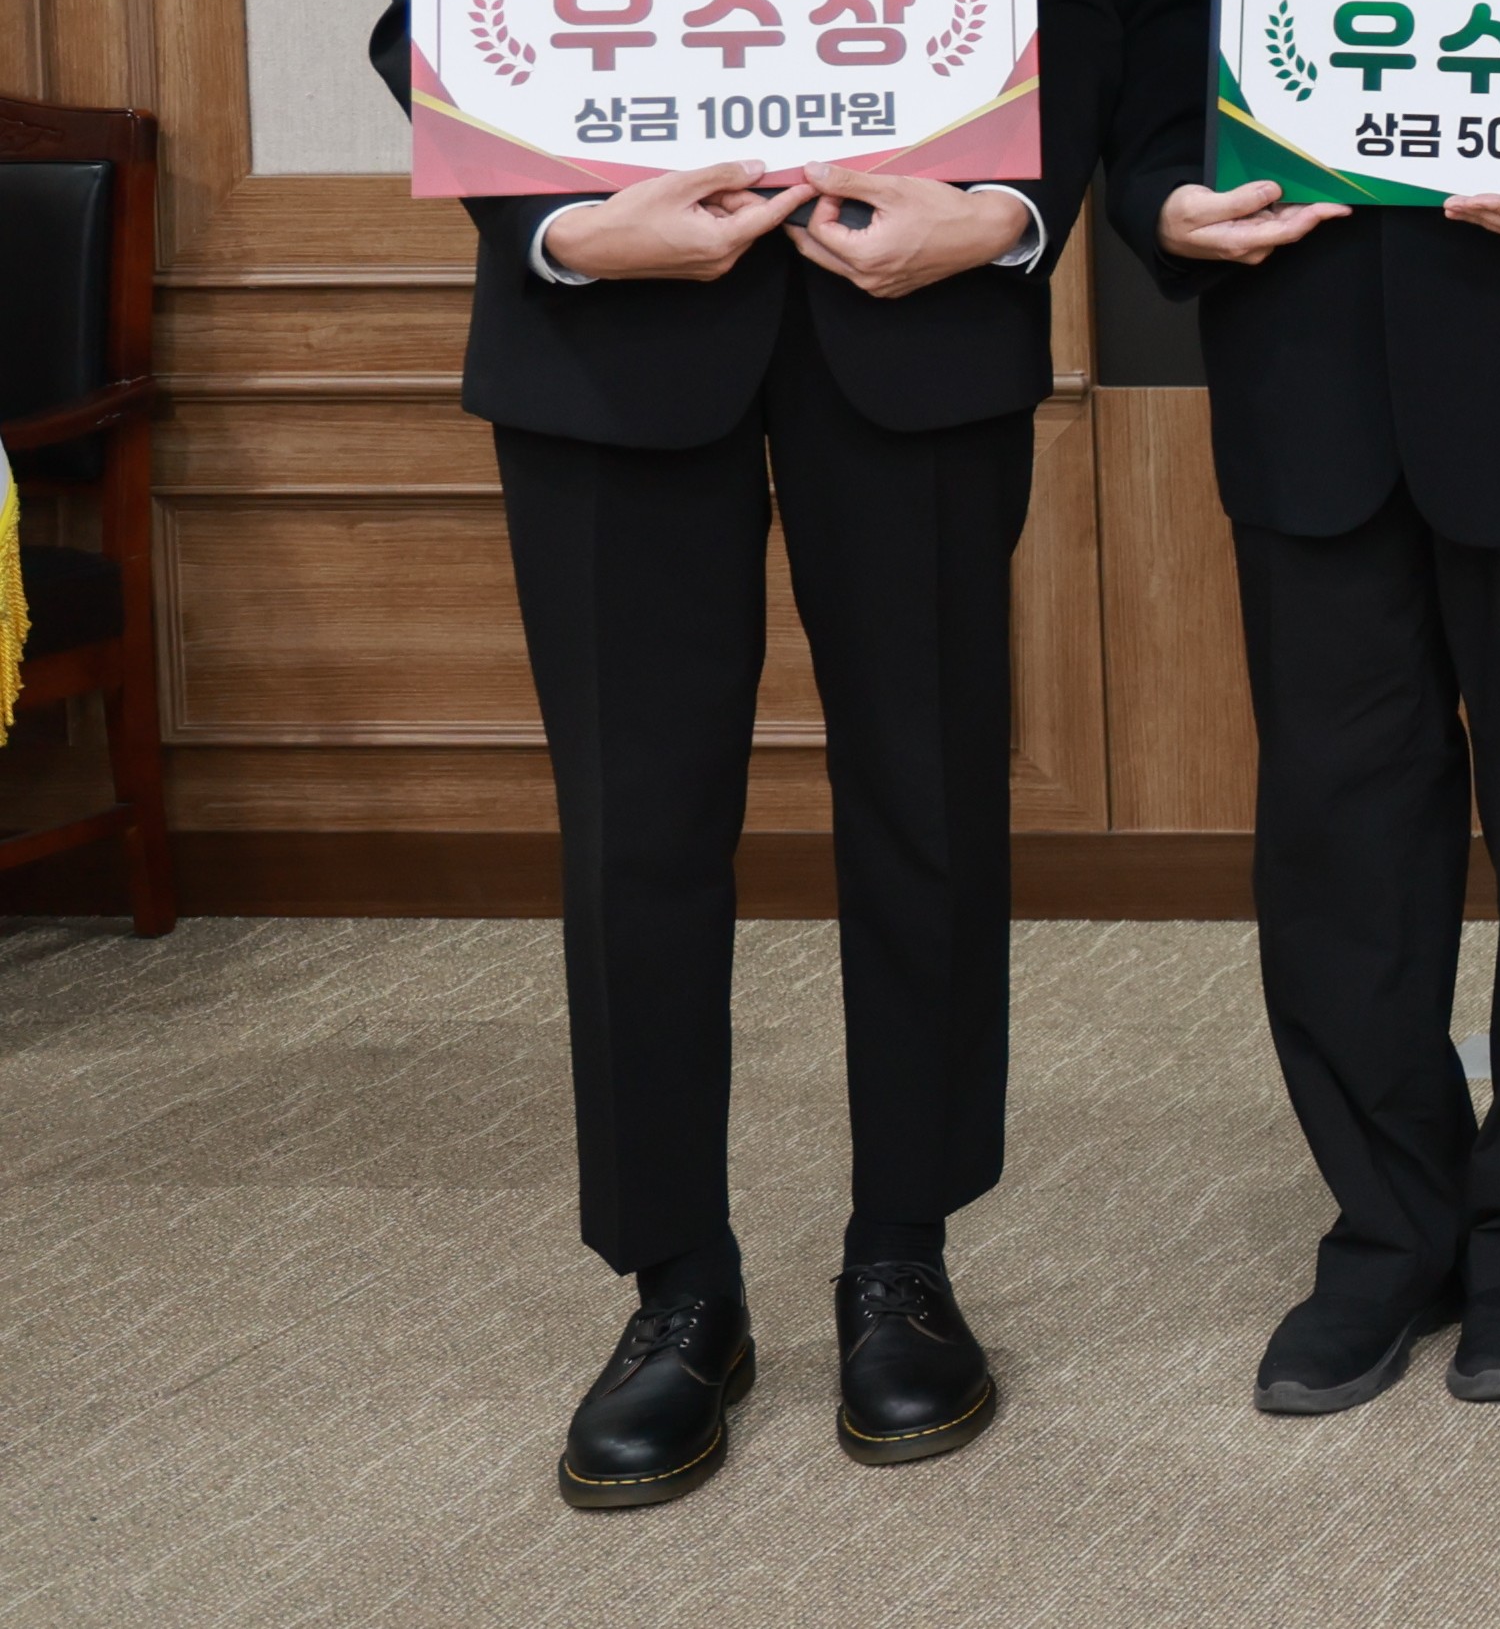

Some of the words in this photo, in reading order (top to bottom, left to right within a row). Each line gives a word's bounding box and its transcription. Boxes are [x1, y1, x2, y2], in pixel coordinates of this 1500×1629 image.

[575, 97, 678, 143] 상금
[698, 92, 895, 139] 100만원
[1356, 113, 1441, 157] 상금
